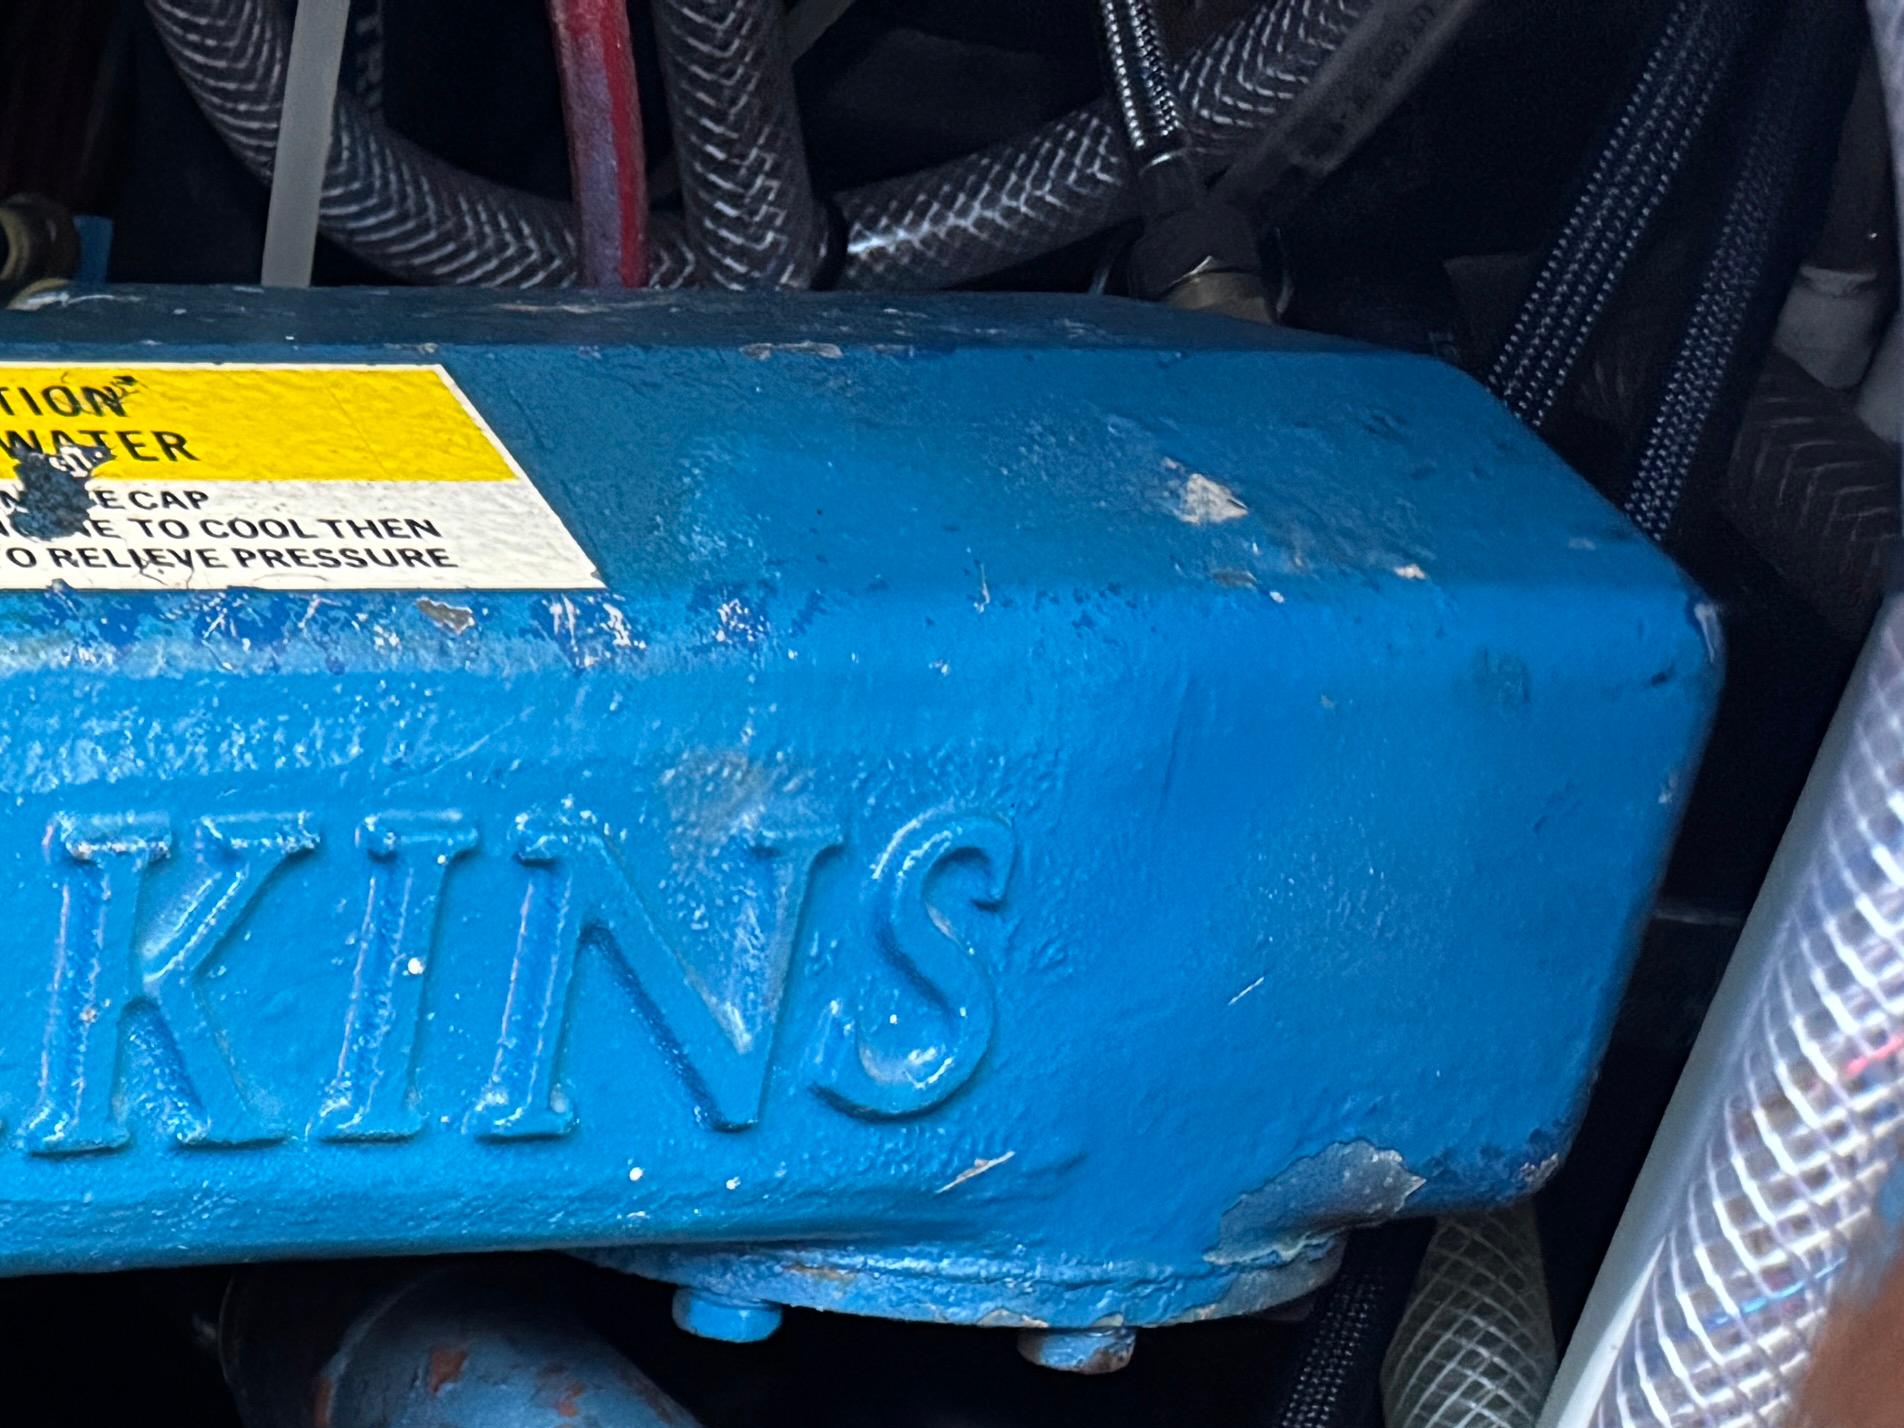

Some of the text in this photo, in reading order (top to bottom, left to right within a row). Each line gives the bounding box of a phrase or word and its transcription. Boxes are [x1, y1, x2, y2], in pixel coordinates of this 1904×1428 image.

[128, 488, 210, 511] CAP
[126, 517, 191, 540] TO
[198, 517, 320, 541] COOL
[316, 517, 443, 540] THEN
[46, 547, 229, 570] RELIEVE
[229, 547, 460, 569] PRESSURE
